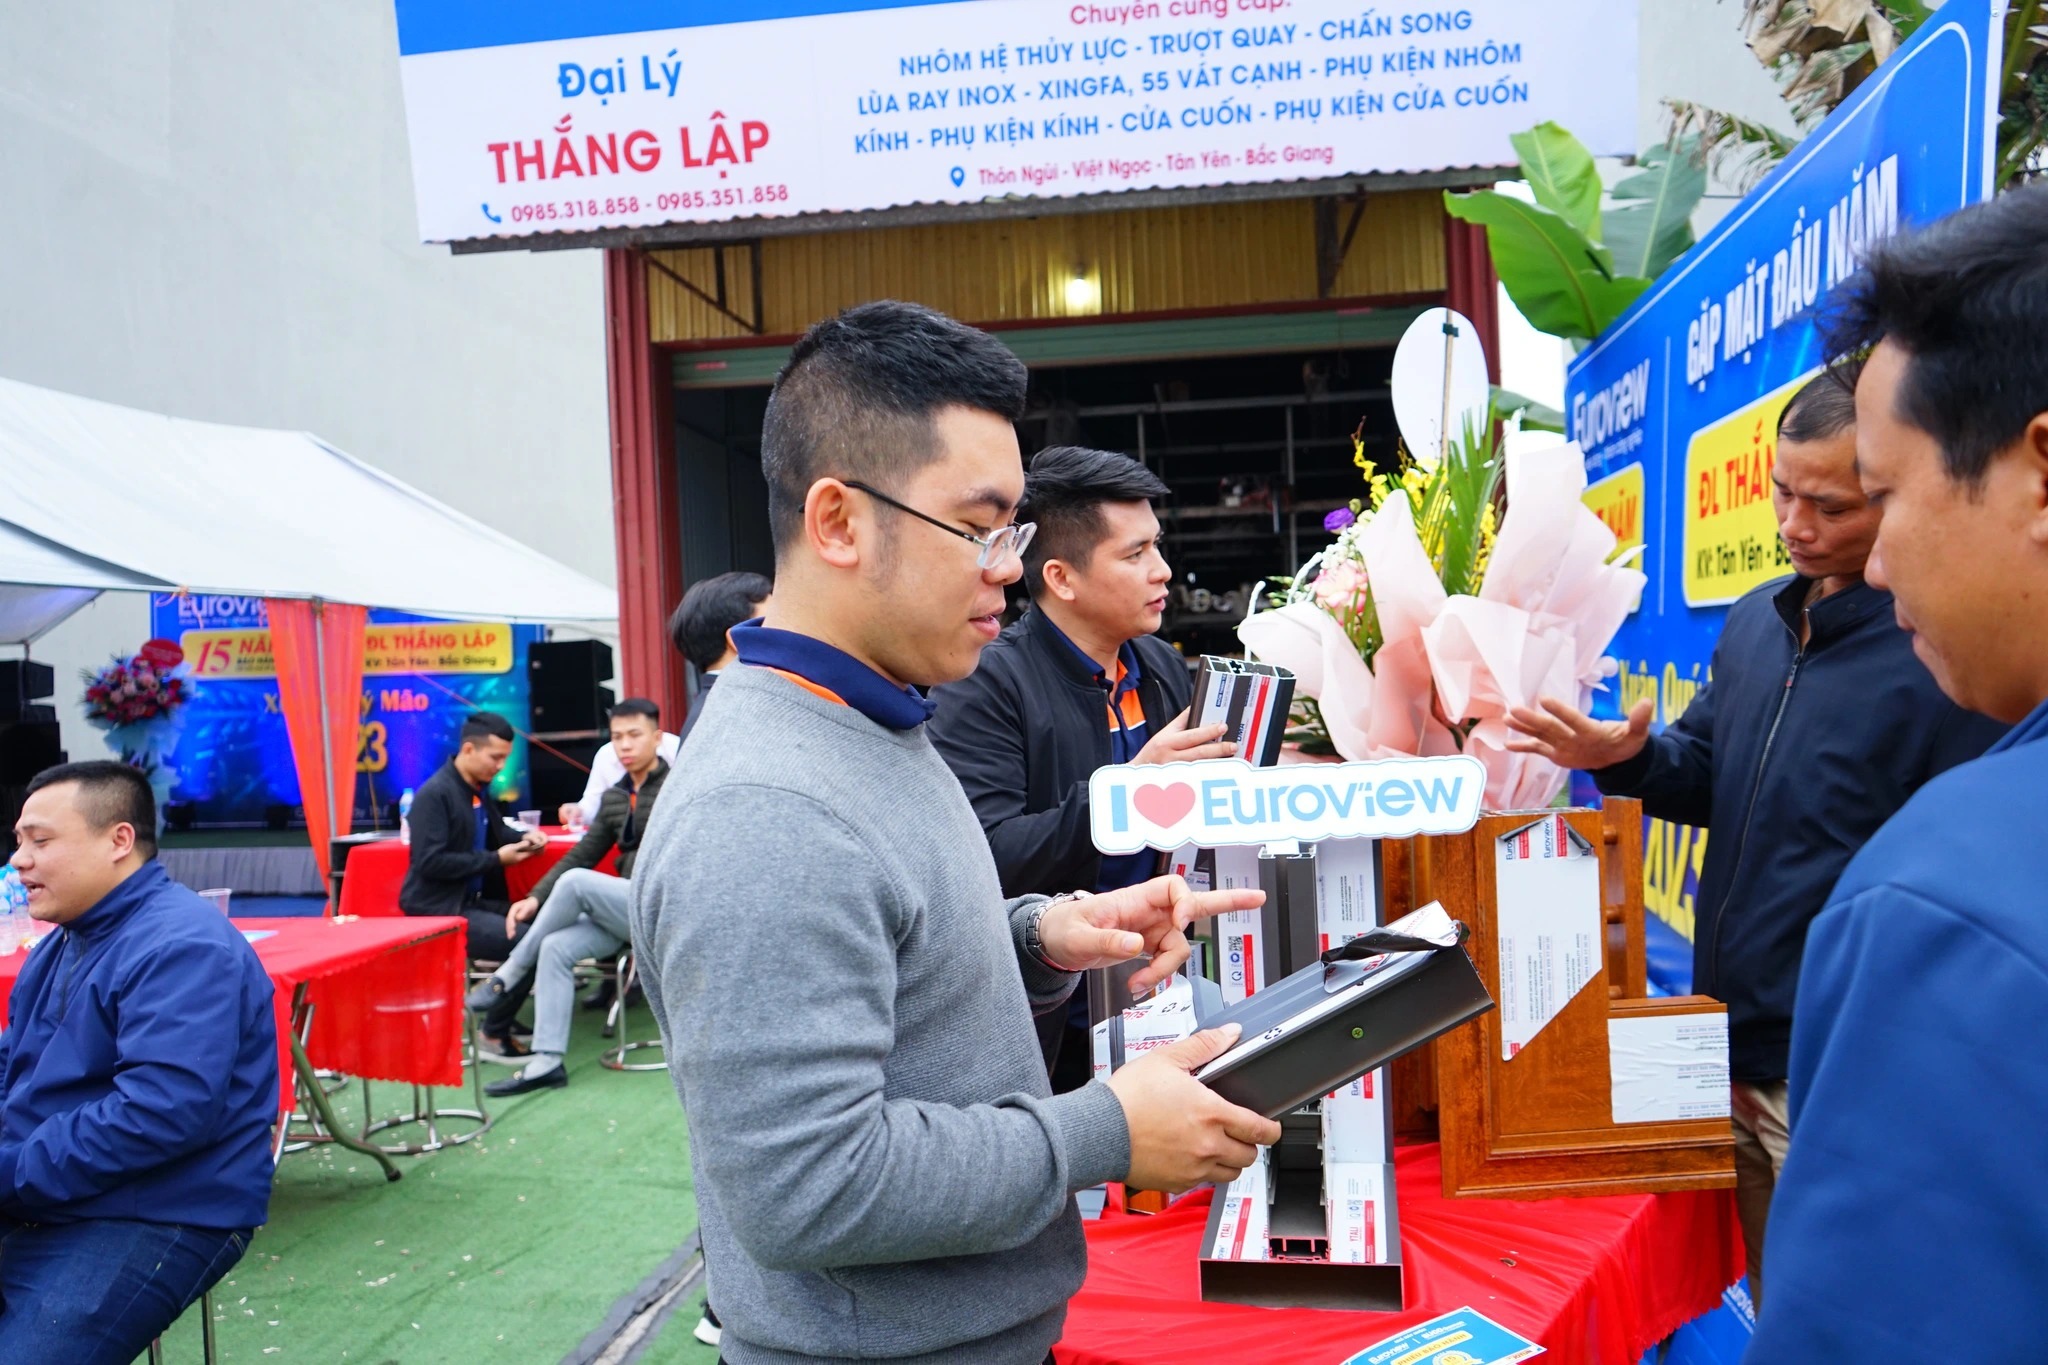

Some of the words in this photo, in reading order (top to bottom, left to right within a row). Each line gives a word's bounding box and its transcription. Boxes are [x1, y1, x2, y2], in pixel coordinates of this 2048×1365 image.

[899, 48, 972, 76] NHÔM
[981, 43, 1008, 73] HỆ
[1016, 37, 1073, 66] THỦY
[1083, 36, 1127, 66] LỰC
[1150, 29, 1223, 58] TRƯỢT
[1231, 23, 1298, 49] QUAY
[1319, 8, 1392, 41] CHẤN
[1401, 10, 1473, 35] SONG
[557, 58, 626, 106] Đại
[642, 49, 682, 97] Lý
[858, 90, 900, 116] LÙA
[908, 89, 950, 112] RAY
[959, 83, 1016, 107] INOX
[1039, 75, 1134, 100] XINGFA,
[1142, 71, 1170, 93] 55
[1231, 60, 1302, 89] CẠNH
[1325, 55, 1372, 81] PHỤ
[1383, 45, 1436, 77] KIỆN
[1445, 40, 1522, 69] NHÔM
[854, 126, 909, 154] KÍNH
[930, 125, 976, 150] PHỤ
[984, 116, 1035, 148] KIỆN
[1044, 111, 1099, 139] KÍNH
[1121, 107, 1172, 133] CỬA
[1181, 96, 1253, 128] CUỐN
[1274, 97, 1322, 126] PHỤ
[1332, 89, 1384, 121] KIỆN
[1392, 82, 1446, 113] CỬA
[1455, 75, 1529, 107] CUỐN
[487, 113, 661, 183] THẮNG
[680, 110, 770, 179] LẬP
[1282, 143, 1334, 166] Giang
[511, 196, 639, 224] 0985.318.858
[657, 185, 789, 212] 0985.351.858
[1686, 296, 1722, 393] GẶP
[1724, 257, 1769, 365] MẶT
[1771, 205, 1822, 330] ĐẦU
[1826, 153, 1898, 291] NĂM
[1574, 358, 1650, 453] Euroview
[1699, 467, 1719, 520] ĐL
[1726, 418, 1775, 512] THẮN
[1716, 541, 1736, 577] Tân
[1740, 536, 1763, 572] Yên
[195, 640, 233, 673] 15
[239, 634, 272, 653] NĂ
[366, 635, 387, 650] ĐL
[393, 629, 457, 650] THẮNG
[463, 630, 496, 652] LẬP
[1110, 785, 1129, 833] I
[1201, 776, 1463, 827] Euroview
